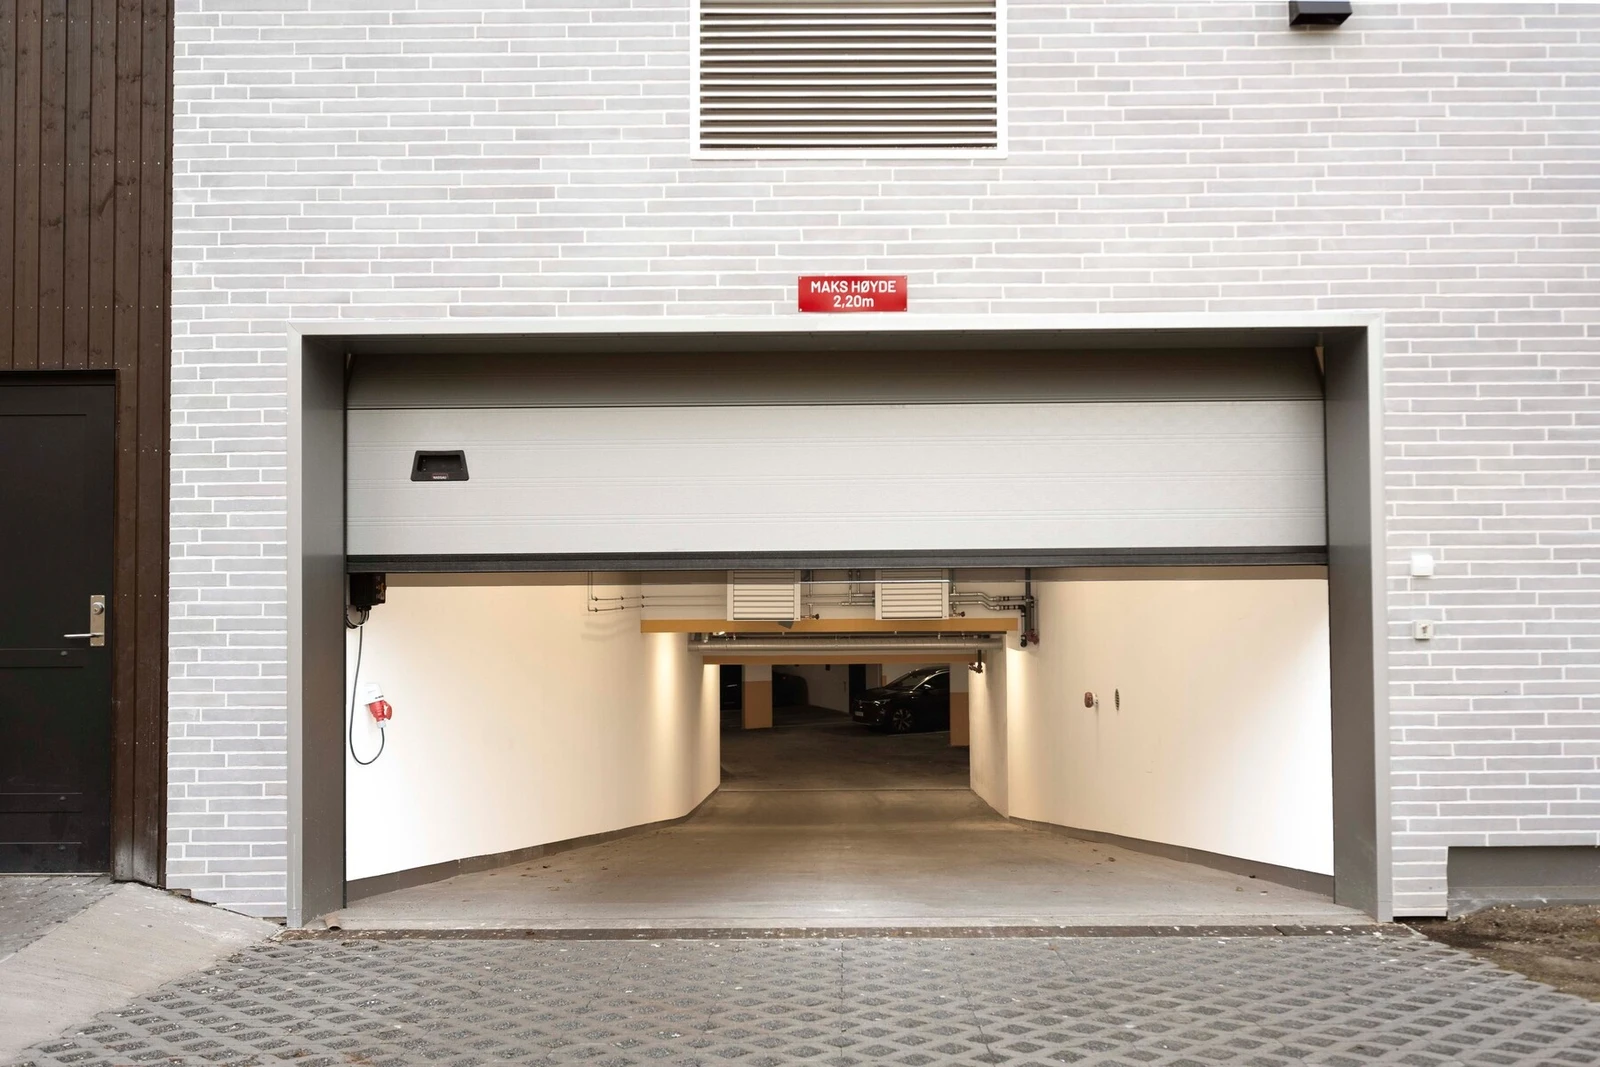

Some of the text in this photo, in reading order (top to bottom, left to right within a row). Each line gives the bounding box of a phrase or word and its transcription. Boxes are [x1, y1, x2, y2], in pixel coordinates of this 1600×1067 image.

[811, 281, 897, 293] MAKS HØYDE
[833, 295, 875, 308] 2,20m
